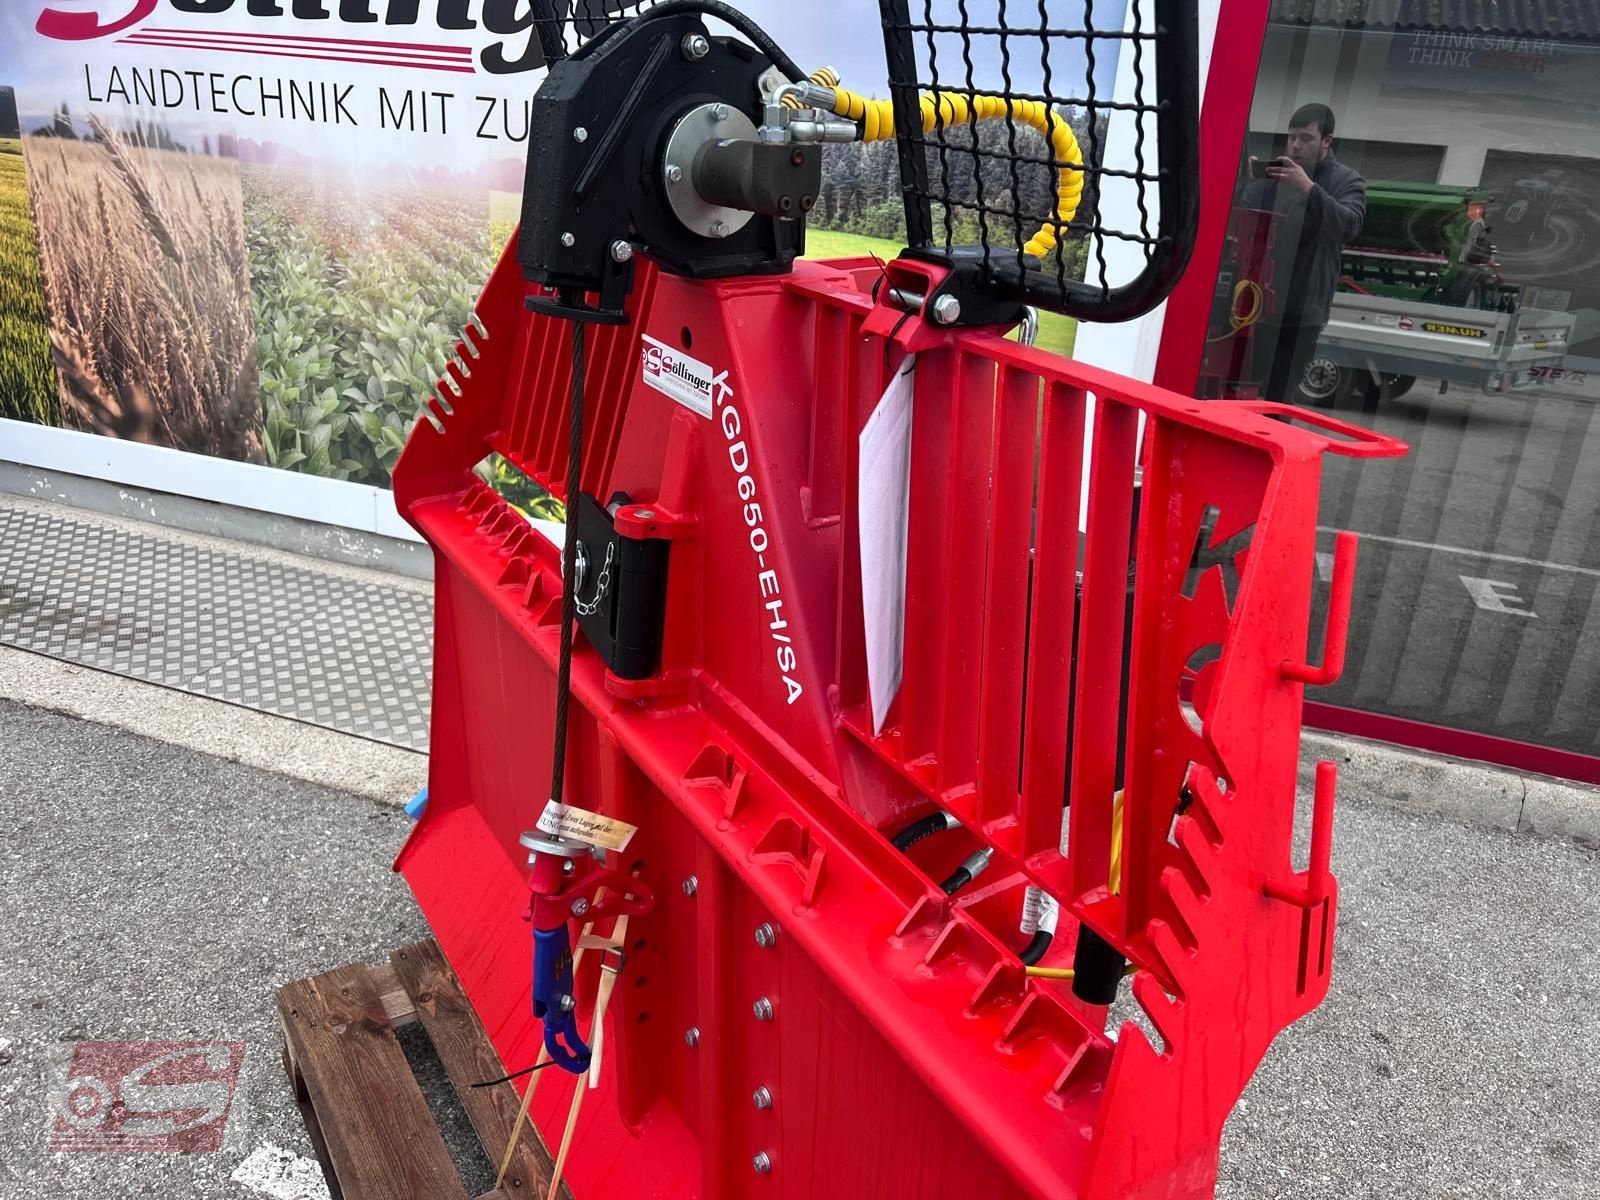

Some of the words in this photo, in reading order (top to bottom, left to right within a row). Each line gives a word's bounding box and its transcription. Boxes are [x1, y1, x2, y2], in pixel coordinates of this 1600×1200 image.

[1413, 30, 1477, 49] THINK
[1408, 48, 1475, 67] THINK
[85, 64, 358, 126] LANDTECHNIK
[379, 87, 454, 135] MIT
[661, 355, 711, 391] Söllinger
[1527, 366, 1587, 384] STEYR
[712, 369, 803, 705] KGD650-EH/SA
